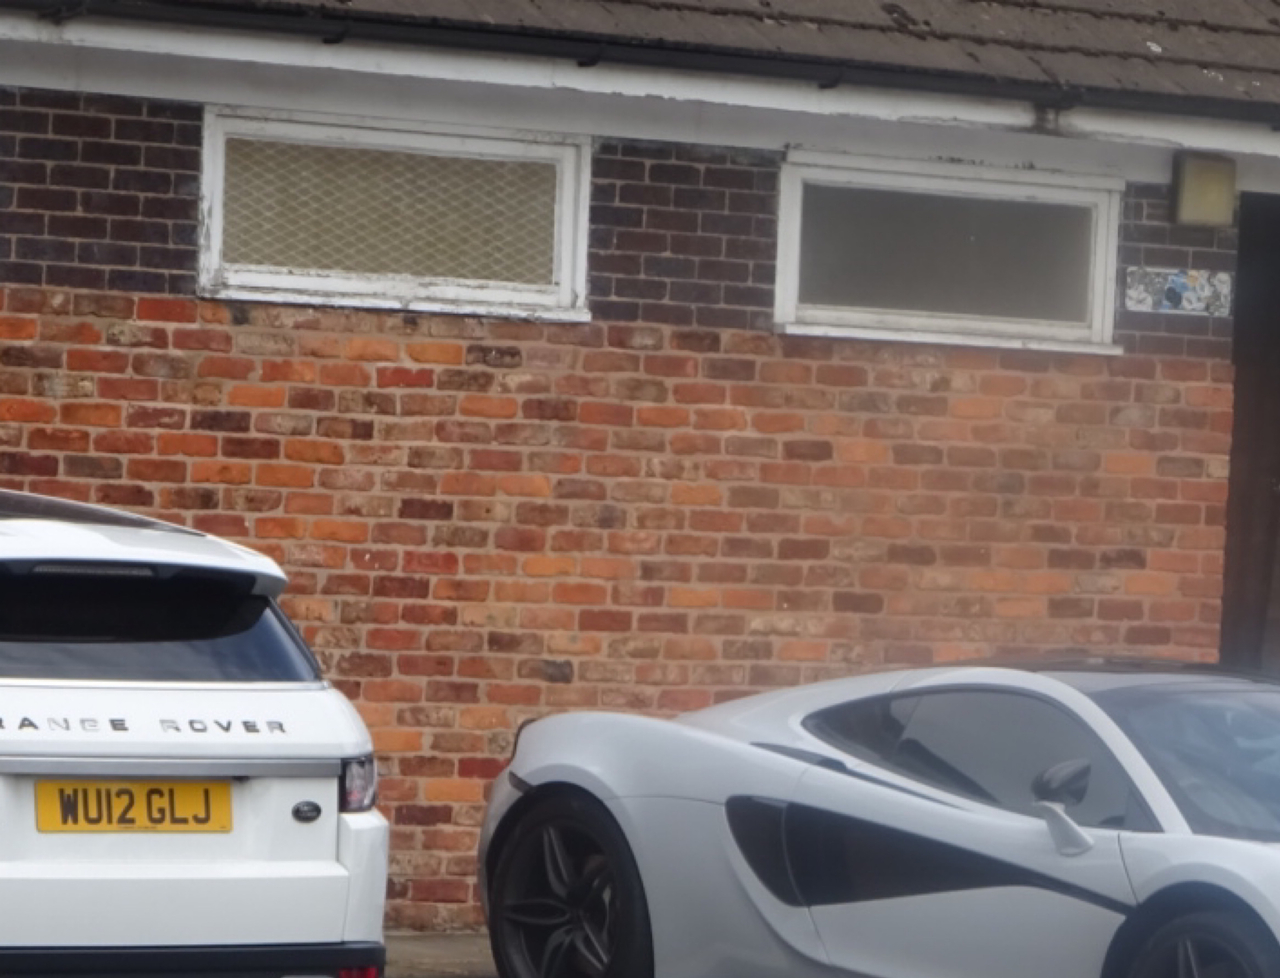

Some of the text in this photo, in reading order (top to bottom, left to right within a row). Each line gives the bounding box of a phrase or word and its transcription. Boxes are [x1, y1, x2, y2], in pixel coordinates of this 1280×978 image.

[159, 719, 286, 733] ROVER
[58, 788, 211, 825] WU12 GLJ
